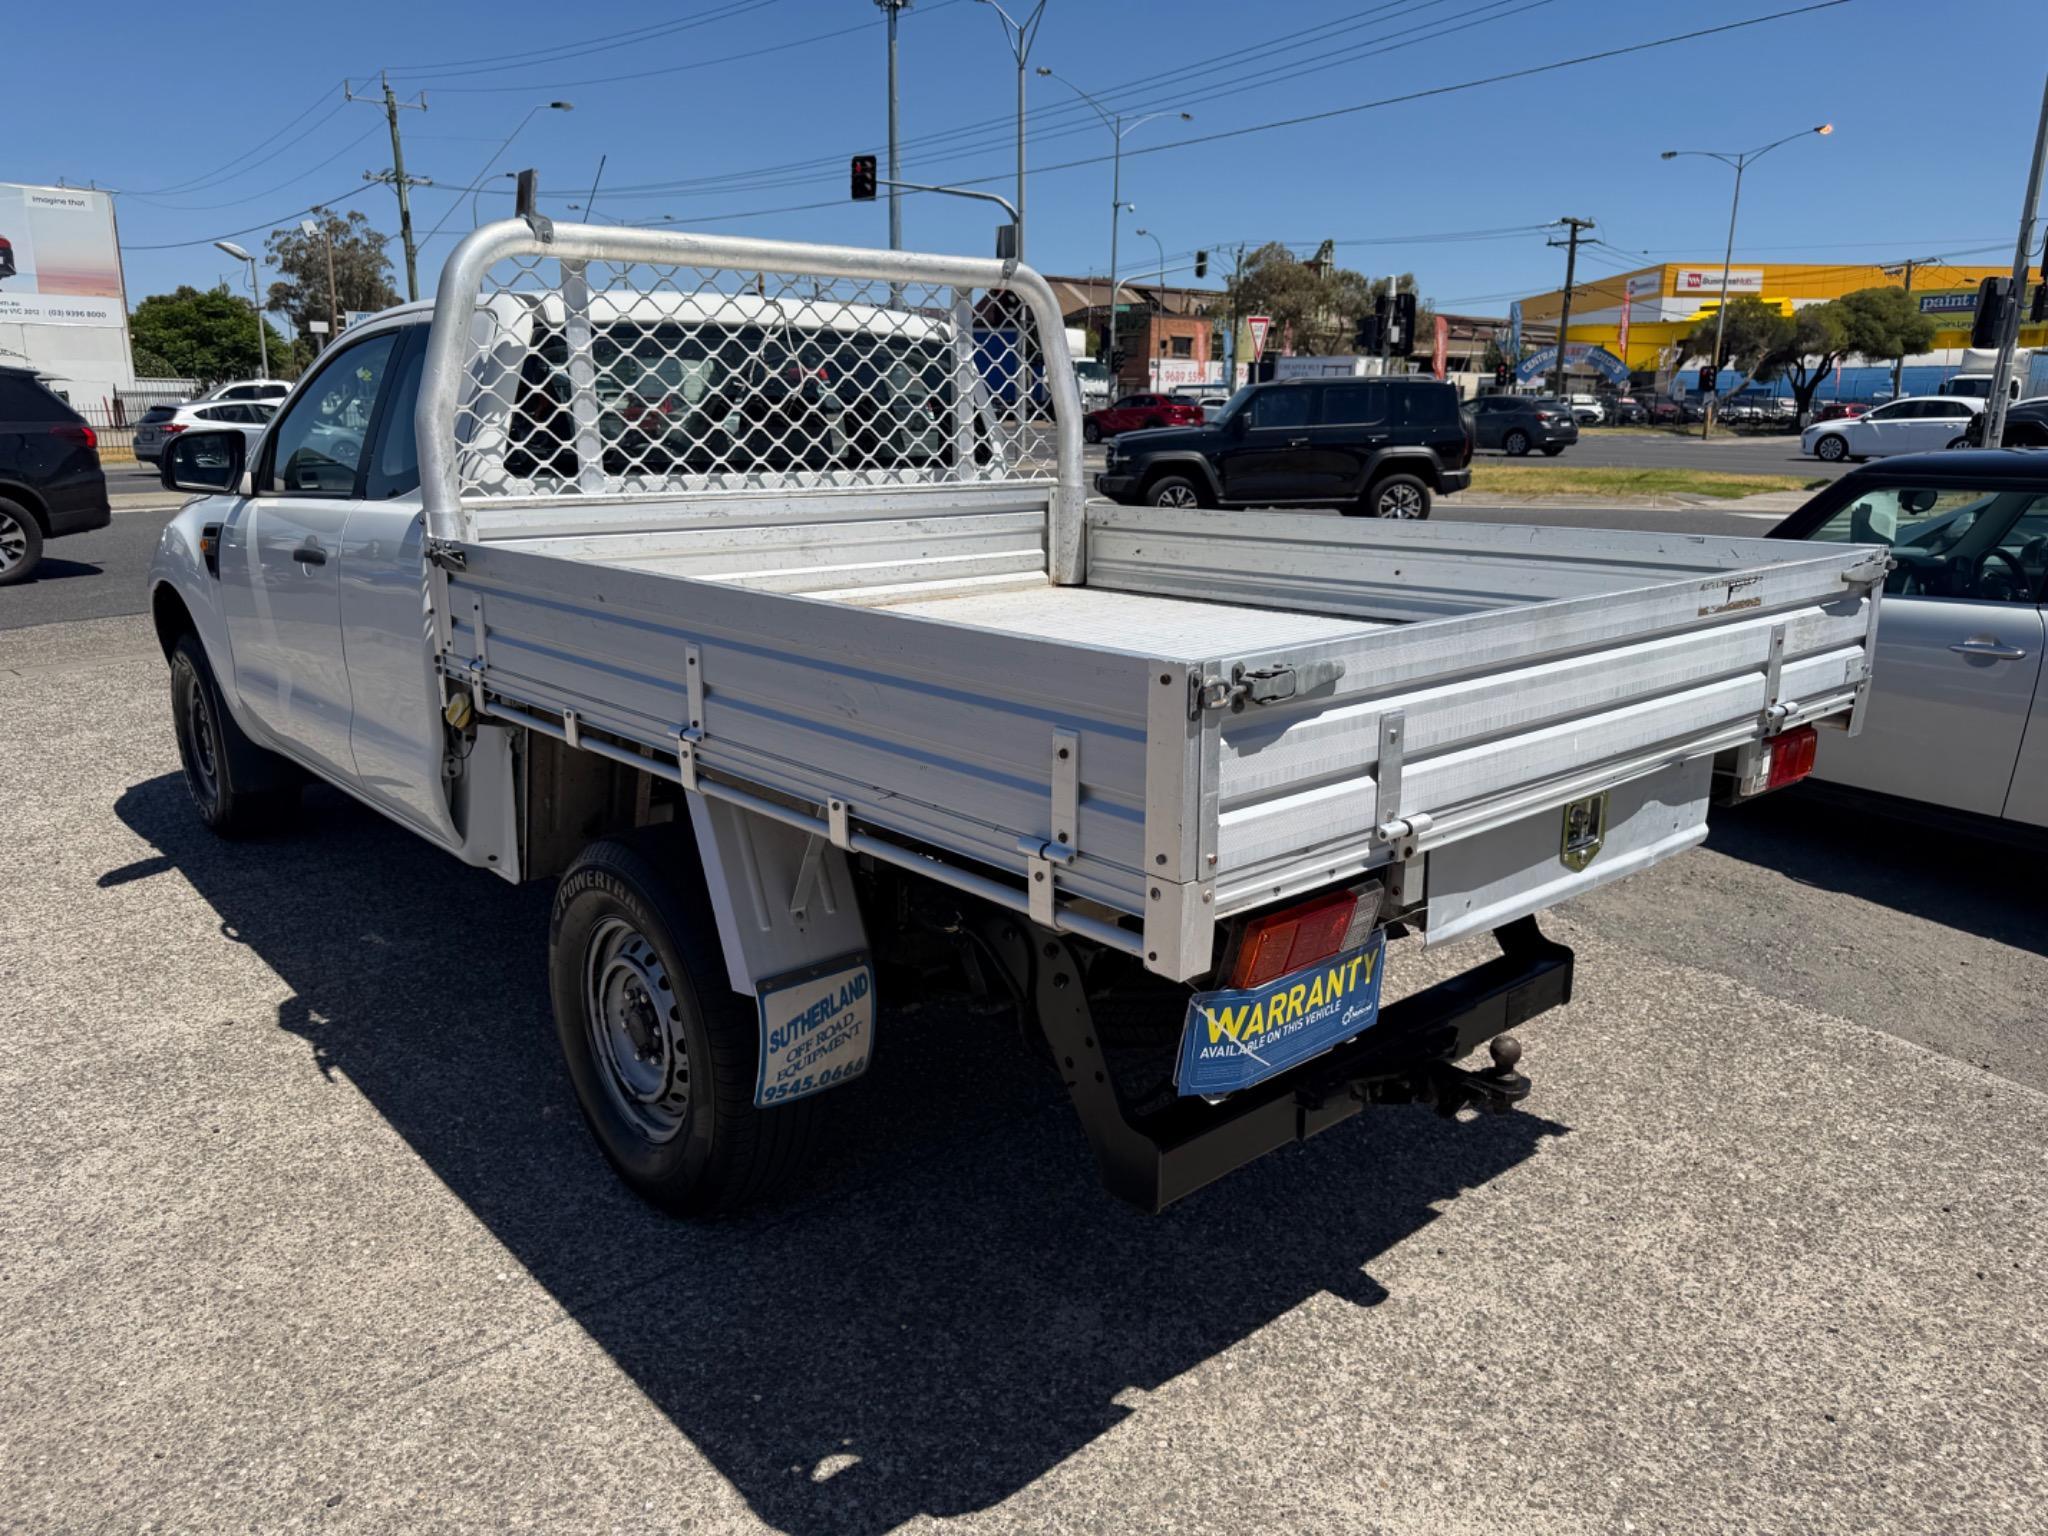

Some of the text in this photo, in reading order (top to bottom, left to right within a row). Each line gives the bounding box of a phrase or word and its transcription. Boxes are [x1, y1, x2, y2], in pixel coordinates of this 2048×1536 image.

[1921, 292, 1971, 312] paint
[769, 972, 869, 1054] SUTHERLAND
[1206, 948, 1379, 1044] WARRANTY
[776, 1020, 863, 1082] EQUIPMENT
[786, 1012, 855, 1063] OFF ROAD
[1199, 999, 1342, 1060] AVAILABLE ON THIS VEHICLE
